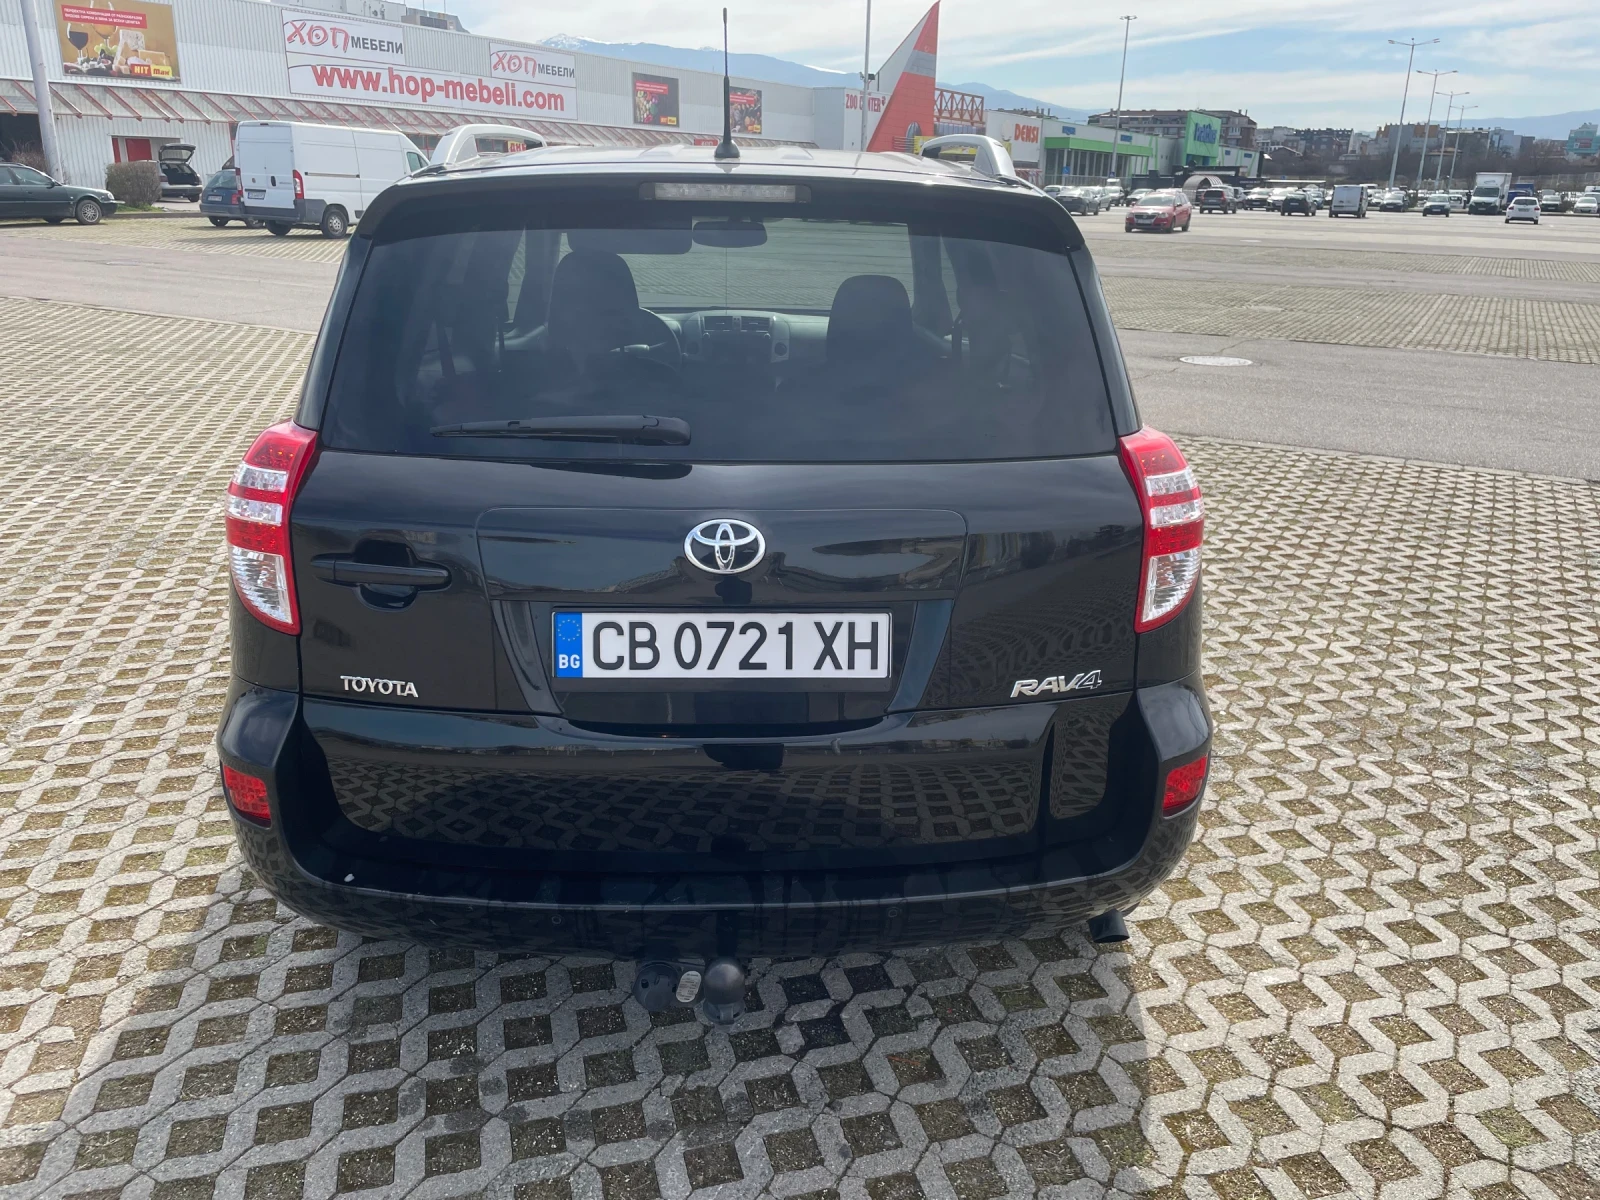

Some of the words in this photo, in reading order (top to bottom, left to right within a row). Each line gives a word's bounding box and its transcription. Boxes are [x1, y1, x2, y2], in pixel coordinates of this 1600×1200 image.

[287, 20, 350, 53] ХОП
[351, 36, 404, 54] МЕБЕЛИ
[134, 65, 149, 75] HIT
[493, 51, 537, 78] ХОП
[538, 63, 575, 79] МЕБЕЛИ
[311, 65, 565, 112] www.hop-mebeli.com
[845, 93, 858, 110] ZOO
[1014, 123, 1040, 144] DENSI
[592, 621, 660, 671] CB
[673, 621, 794, 671] 0721
[813, 621, 879, 671] XH
[558, 654, 580, 669] BG
[340, 675, 419, 698] TOYOTA
[1010, 669, 1102, 698] RAV4
